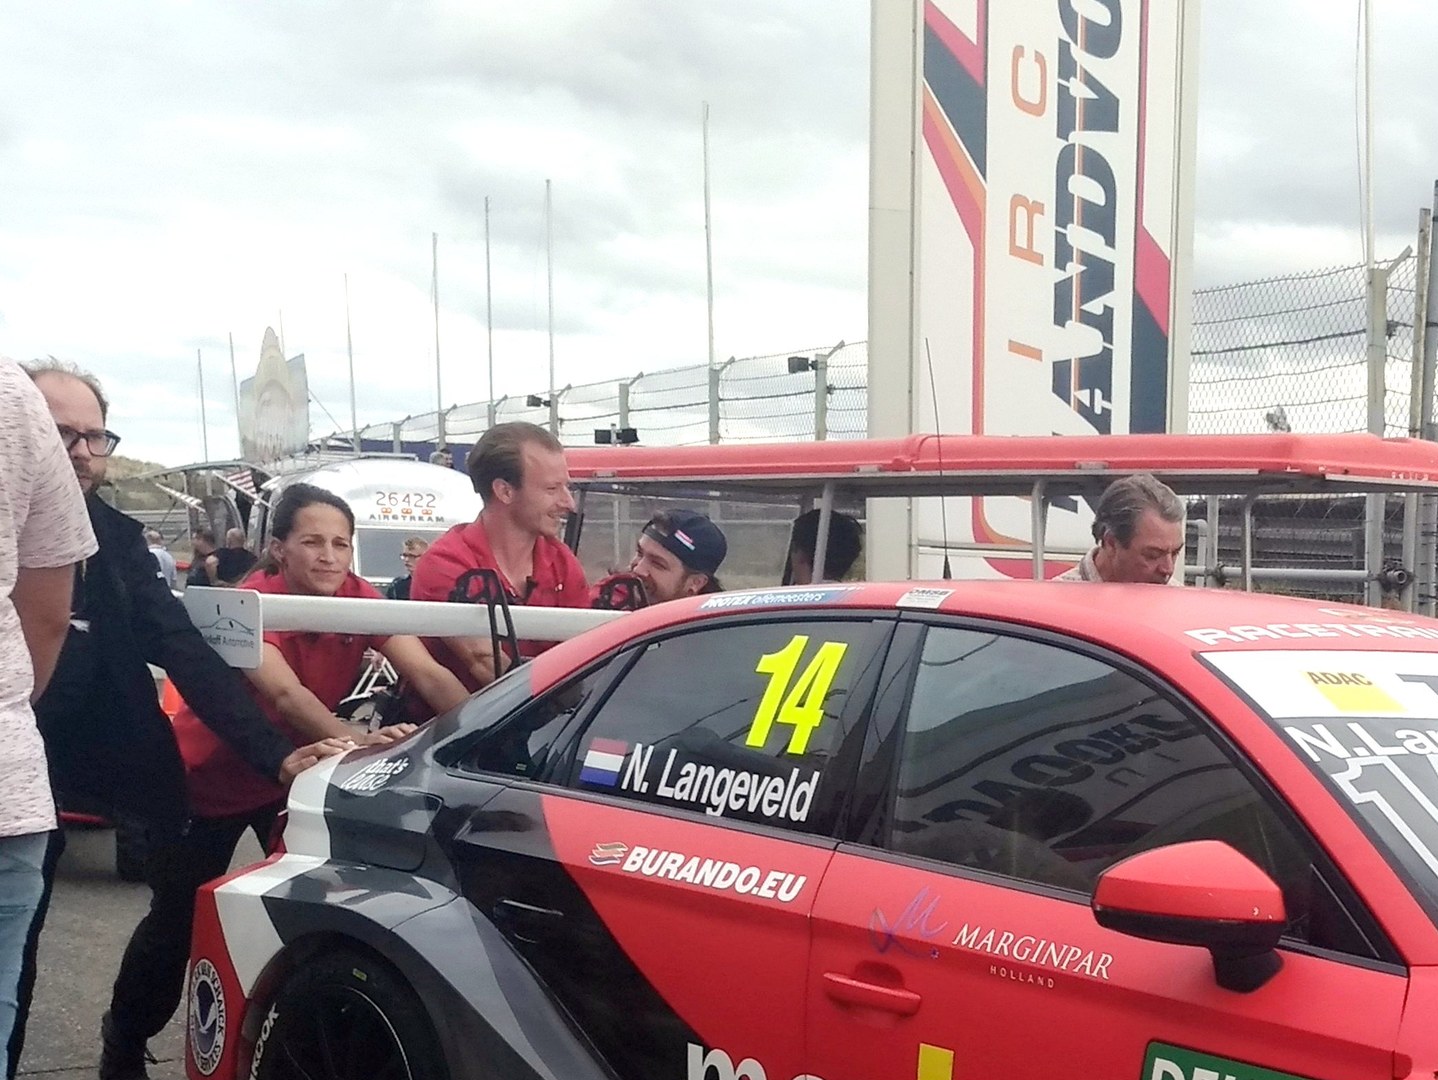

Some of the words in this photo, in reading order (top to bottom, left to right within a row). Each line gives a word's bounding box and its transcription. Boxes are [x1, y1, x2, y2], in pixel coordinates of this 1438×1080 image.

[368, 513, 445, 523] AIRSTREAM
[375, 491, 437, 508] 26422
[745, 635, 849, 756] 14
[1305, 669, 1374, 688] ADAC
[621, 743, 655, 794] N.
[657, 748, 821, 823] Langeveld
[622, 846, 808, 903] BURANDO.EU
[952, 923, 1114, 980] MARGINPAR
[989, 964, 1055, 989] HOLLAND
